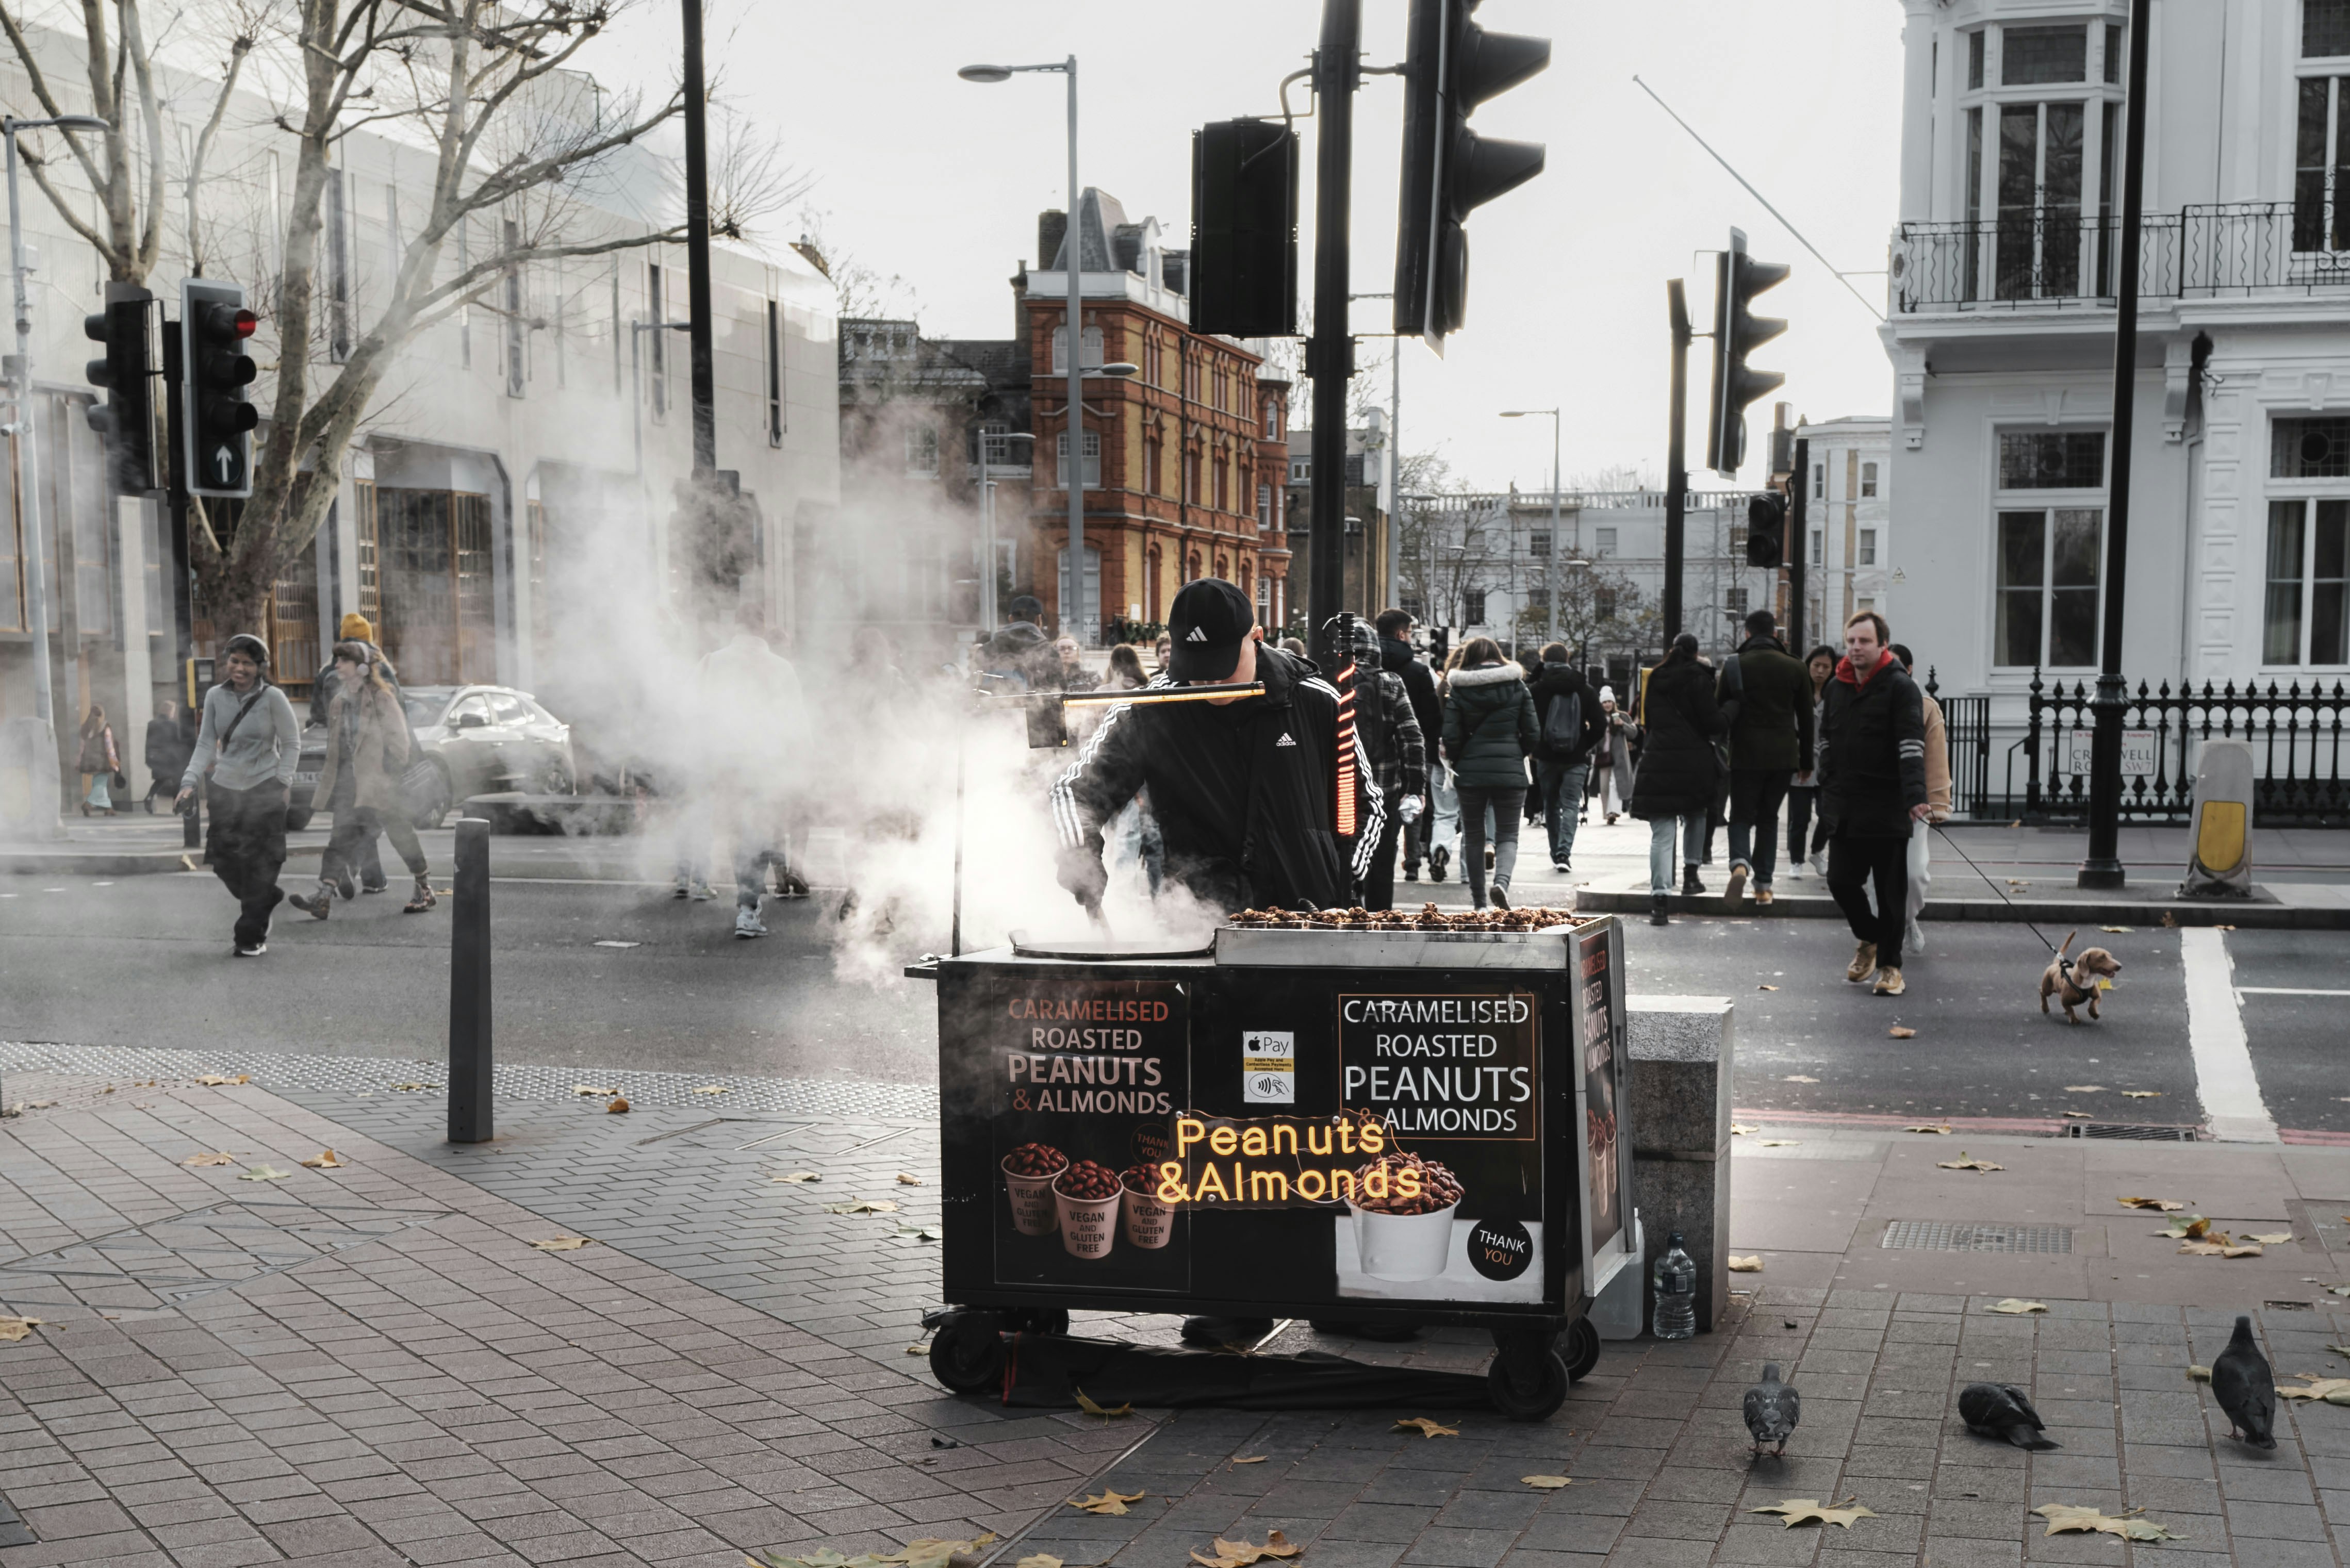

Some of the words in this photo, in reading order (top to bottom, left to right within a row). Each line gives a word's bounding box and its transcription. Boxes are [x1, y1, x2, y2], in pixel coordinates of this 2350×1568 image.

[2125, 762, 2151, 771] SW7
[1008, 998, 1169, 1021] CARAMELISED
[1344, 1000, 1529, 1023] CARAMELISED
[1584, 1005, 1608, 1047] EANUTS
[1032, 1028, 1142, 1050] ROASTED
[1264, 1037, 1289, 1056] Pay
[1376, 1034, 1497, 1057] ROASTED
[1587, 1038, 1611, 1076] ALMONDS
[1008, 1054, 1161, 1086] PEANUTS
[1345, 1066, 1531, 1102] PEANUTS
[1012, 1088, 1032, 1112] &
[1037, 1089, 1171, 1115] ALMONDS
[1383, 1108, 1517, 1131] ALMONDS
[1138, 1133, 1169, 1149] THANK
[1176, 1117, 1384, 1158] Peanuts
[1142, 1147, 1161, 1158] YOU
[1157, 1160, 1421, 1203] &Almonds
[1014, 1187, 1046, 1199] VEGAN
[1069, 1211, 1105, 1223] VEGAN
[1132, 1204, 1166, 1216] VEGAN
[1070, 1232, 1105, 1242] GLUTEN
[1132, 1225, 1164, 1234] GLUTEN
[1138, 1235, 1158, 1244] FREE
[1076, 1244, 1099, 1253] FREE
[1479, 1230, 1526, 1253] THANK
[1485, 1247, 1513, 1265] YOU
